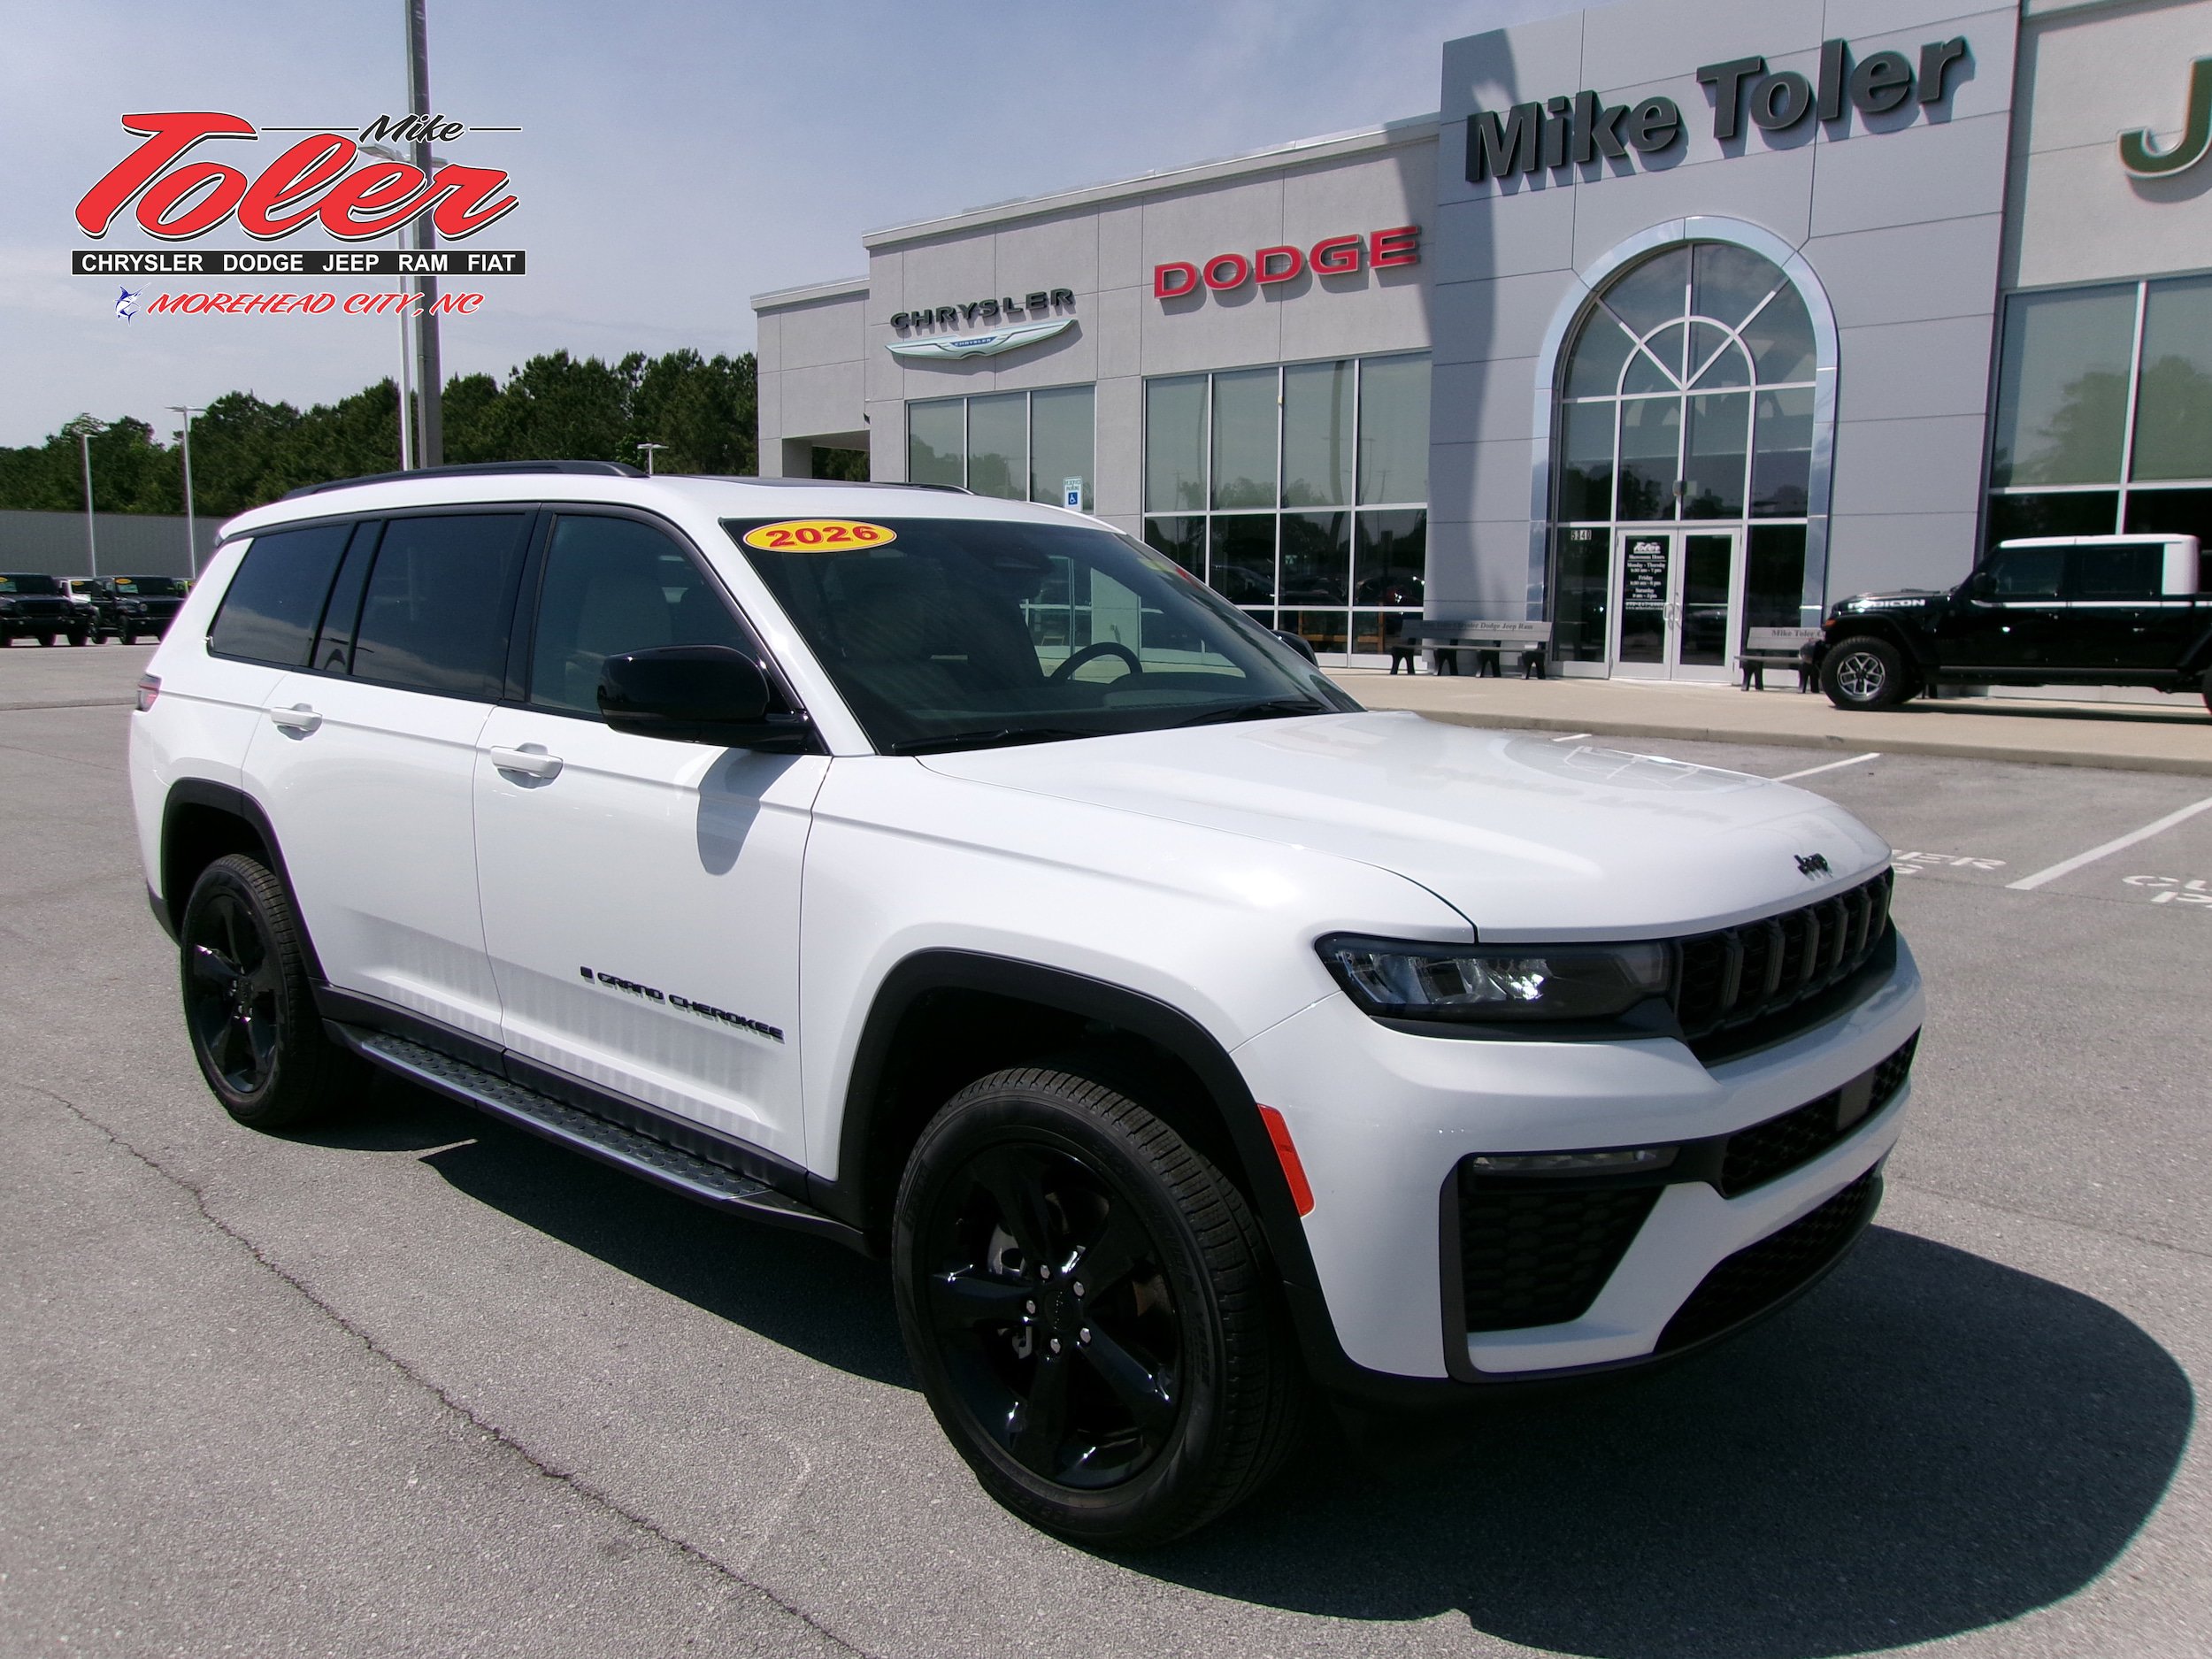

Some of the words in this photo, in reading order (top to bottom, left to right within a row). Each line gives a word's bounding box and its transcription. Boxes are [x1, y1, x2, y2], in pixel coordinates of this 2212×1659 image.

[1464, 89, 1680, 182] Mike
[1696, 35, 1966, 139] Toler
[1154, 225, 1420, 300] DODGE
[890, 288, 1076, 330] CHRYSLER
[765, 526, 880, 548] 2026
[1480, 622, 1501, 631] Dodge
[1502, 622, 1517, 631] Jeep
[597, 972, 664, 1001] GRAND
[669, 994, 786, 1041] CHEROKEE
